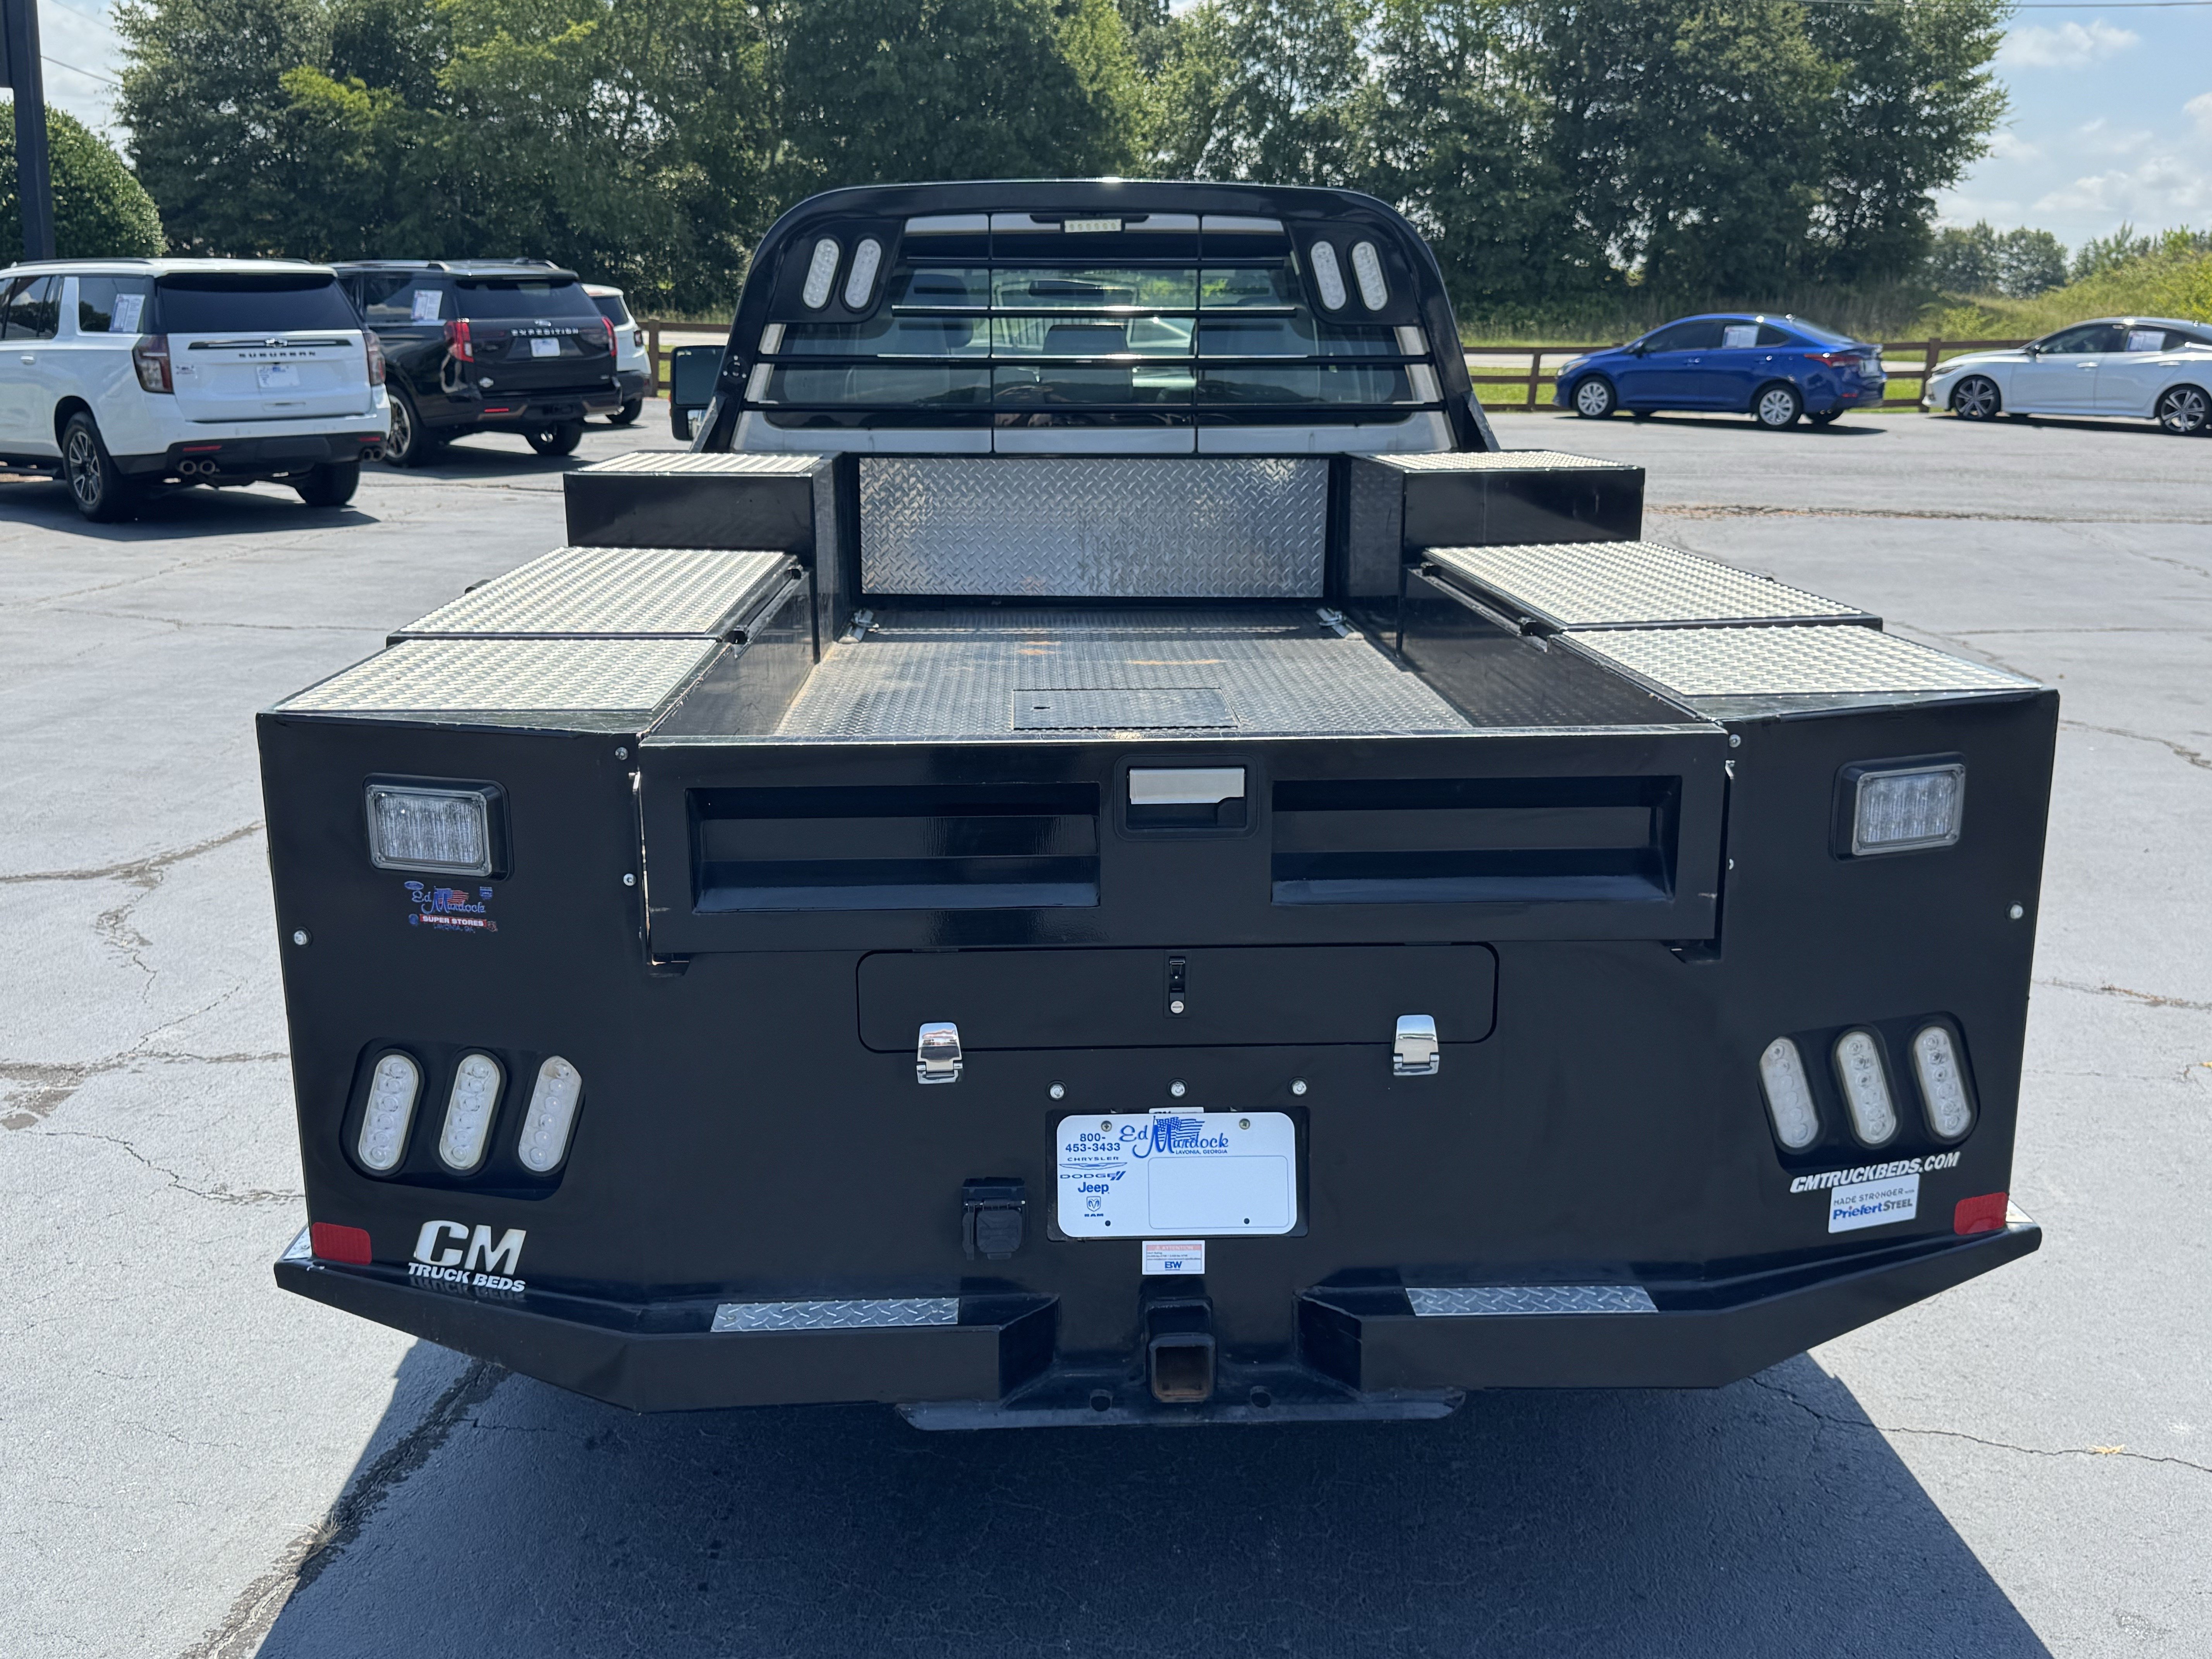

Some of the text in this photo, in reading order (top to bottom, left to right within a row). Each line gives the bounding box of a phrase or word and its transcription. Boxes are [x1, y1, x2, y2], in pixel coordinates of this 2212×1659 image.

[412, 890, 432, 903] Ed
[421, 891, 486, 914] Murdock
[422, 915, 450, 924] SUPER
[452, 918, 484, 927] STORES
[1065, 1142, 1121, 1152] 453-3433
[1079, 1133, 1106, 1142] 800-
[1119, 1124, 1229, 1159] Ed Murdock
[1790, 1151, 1960, 1193] CMTRUCKBEDS.COM
[1077, 1182, 1109, 1194] Jeep
[1834, 1195, 1856, 1206] MADE
[1859, 1187, 1903, 1202] STRONGER
[413, 1220, 527, 1275] CM
[408, 1262, 526, 1293] TRUCK BEDS
